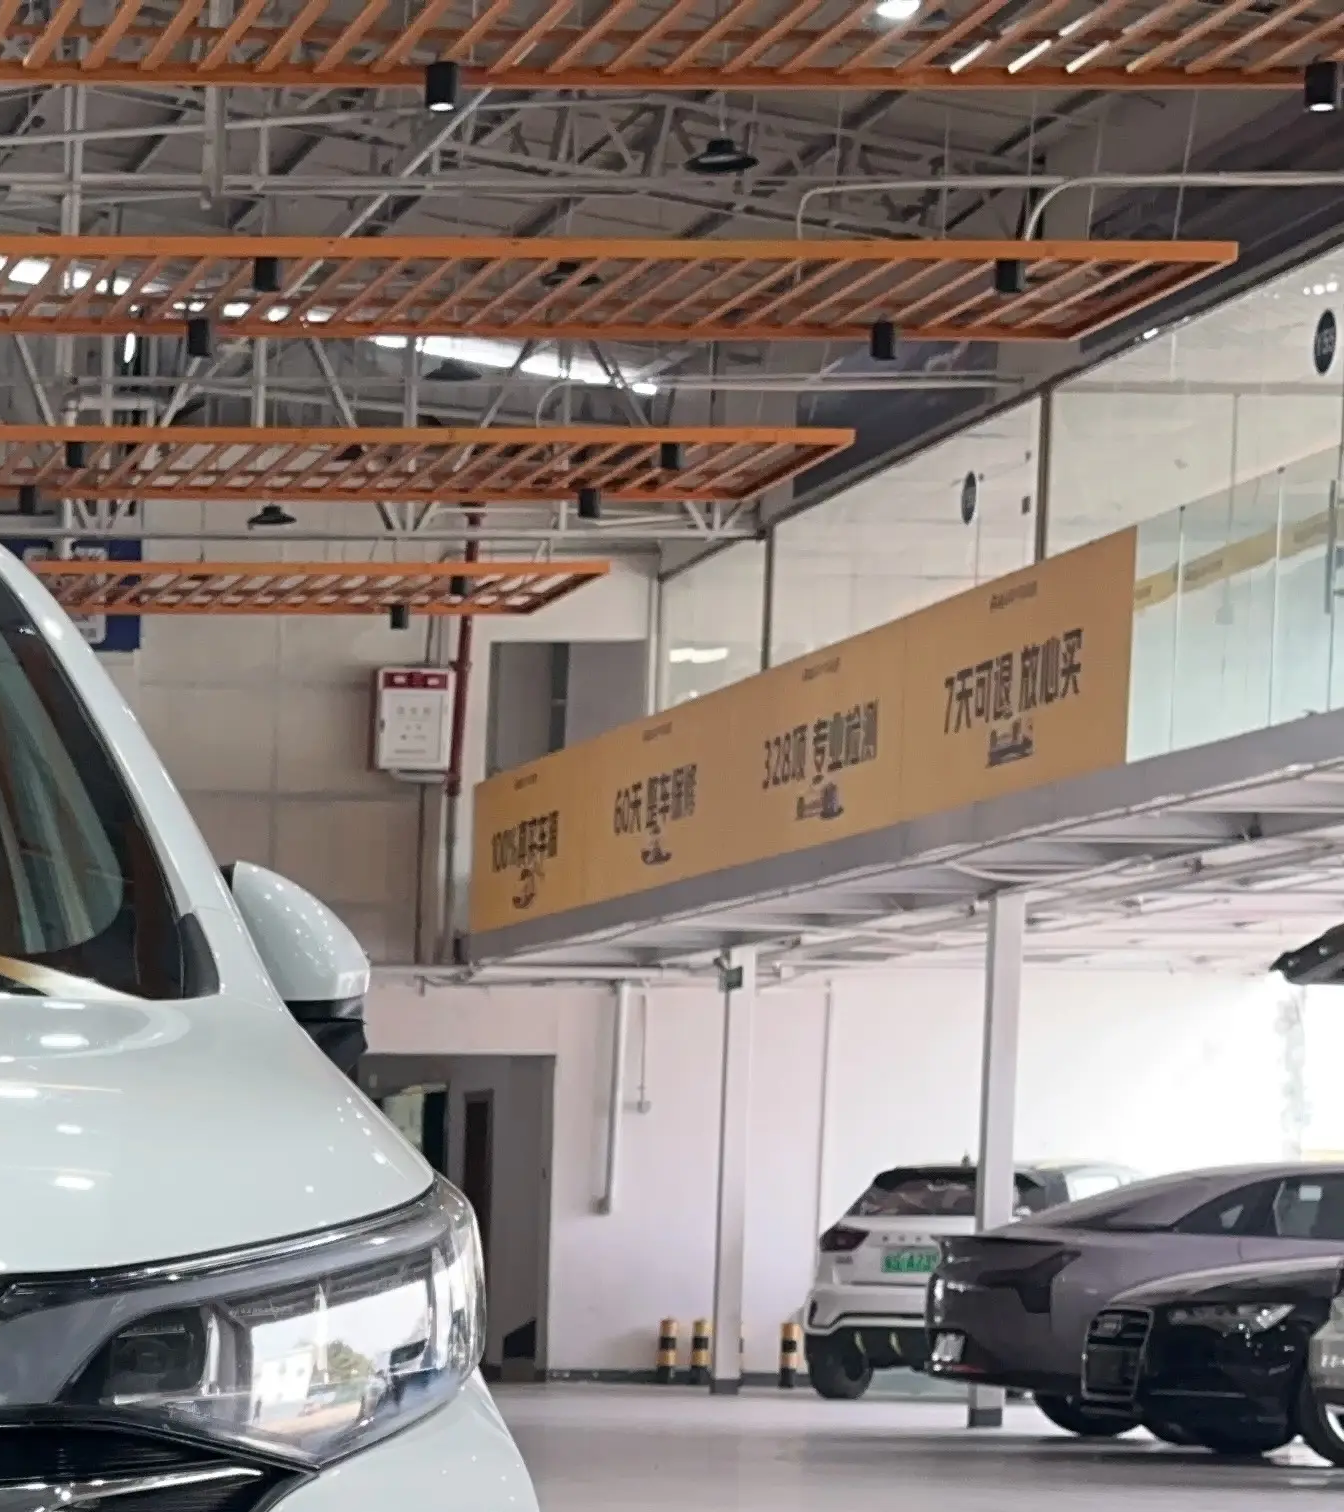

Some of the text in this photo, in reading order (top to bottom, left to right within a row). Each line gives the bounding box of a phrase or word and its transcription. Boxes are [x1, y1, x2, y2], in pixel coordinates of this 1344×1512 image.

[944, 627, 1083, 735] 7天可退 放心买
